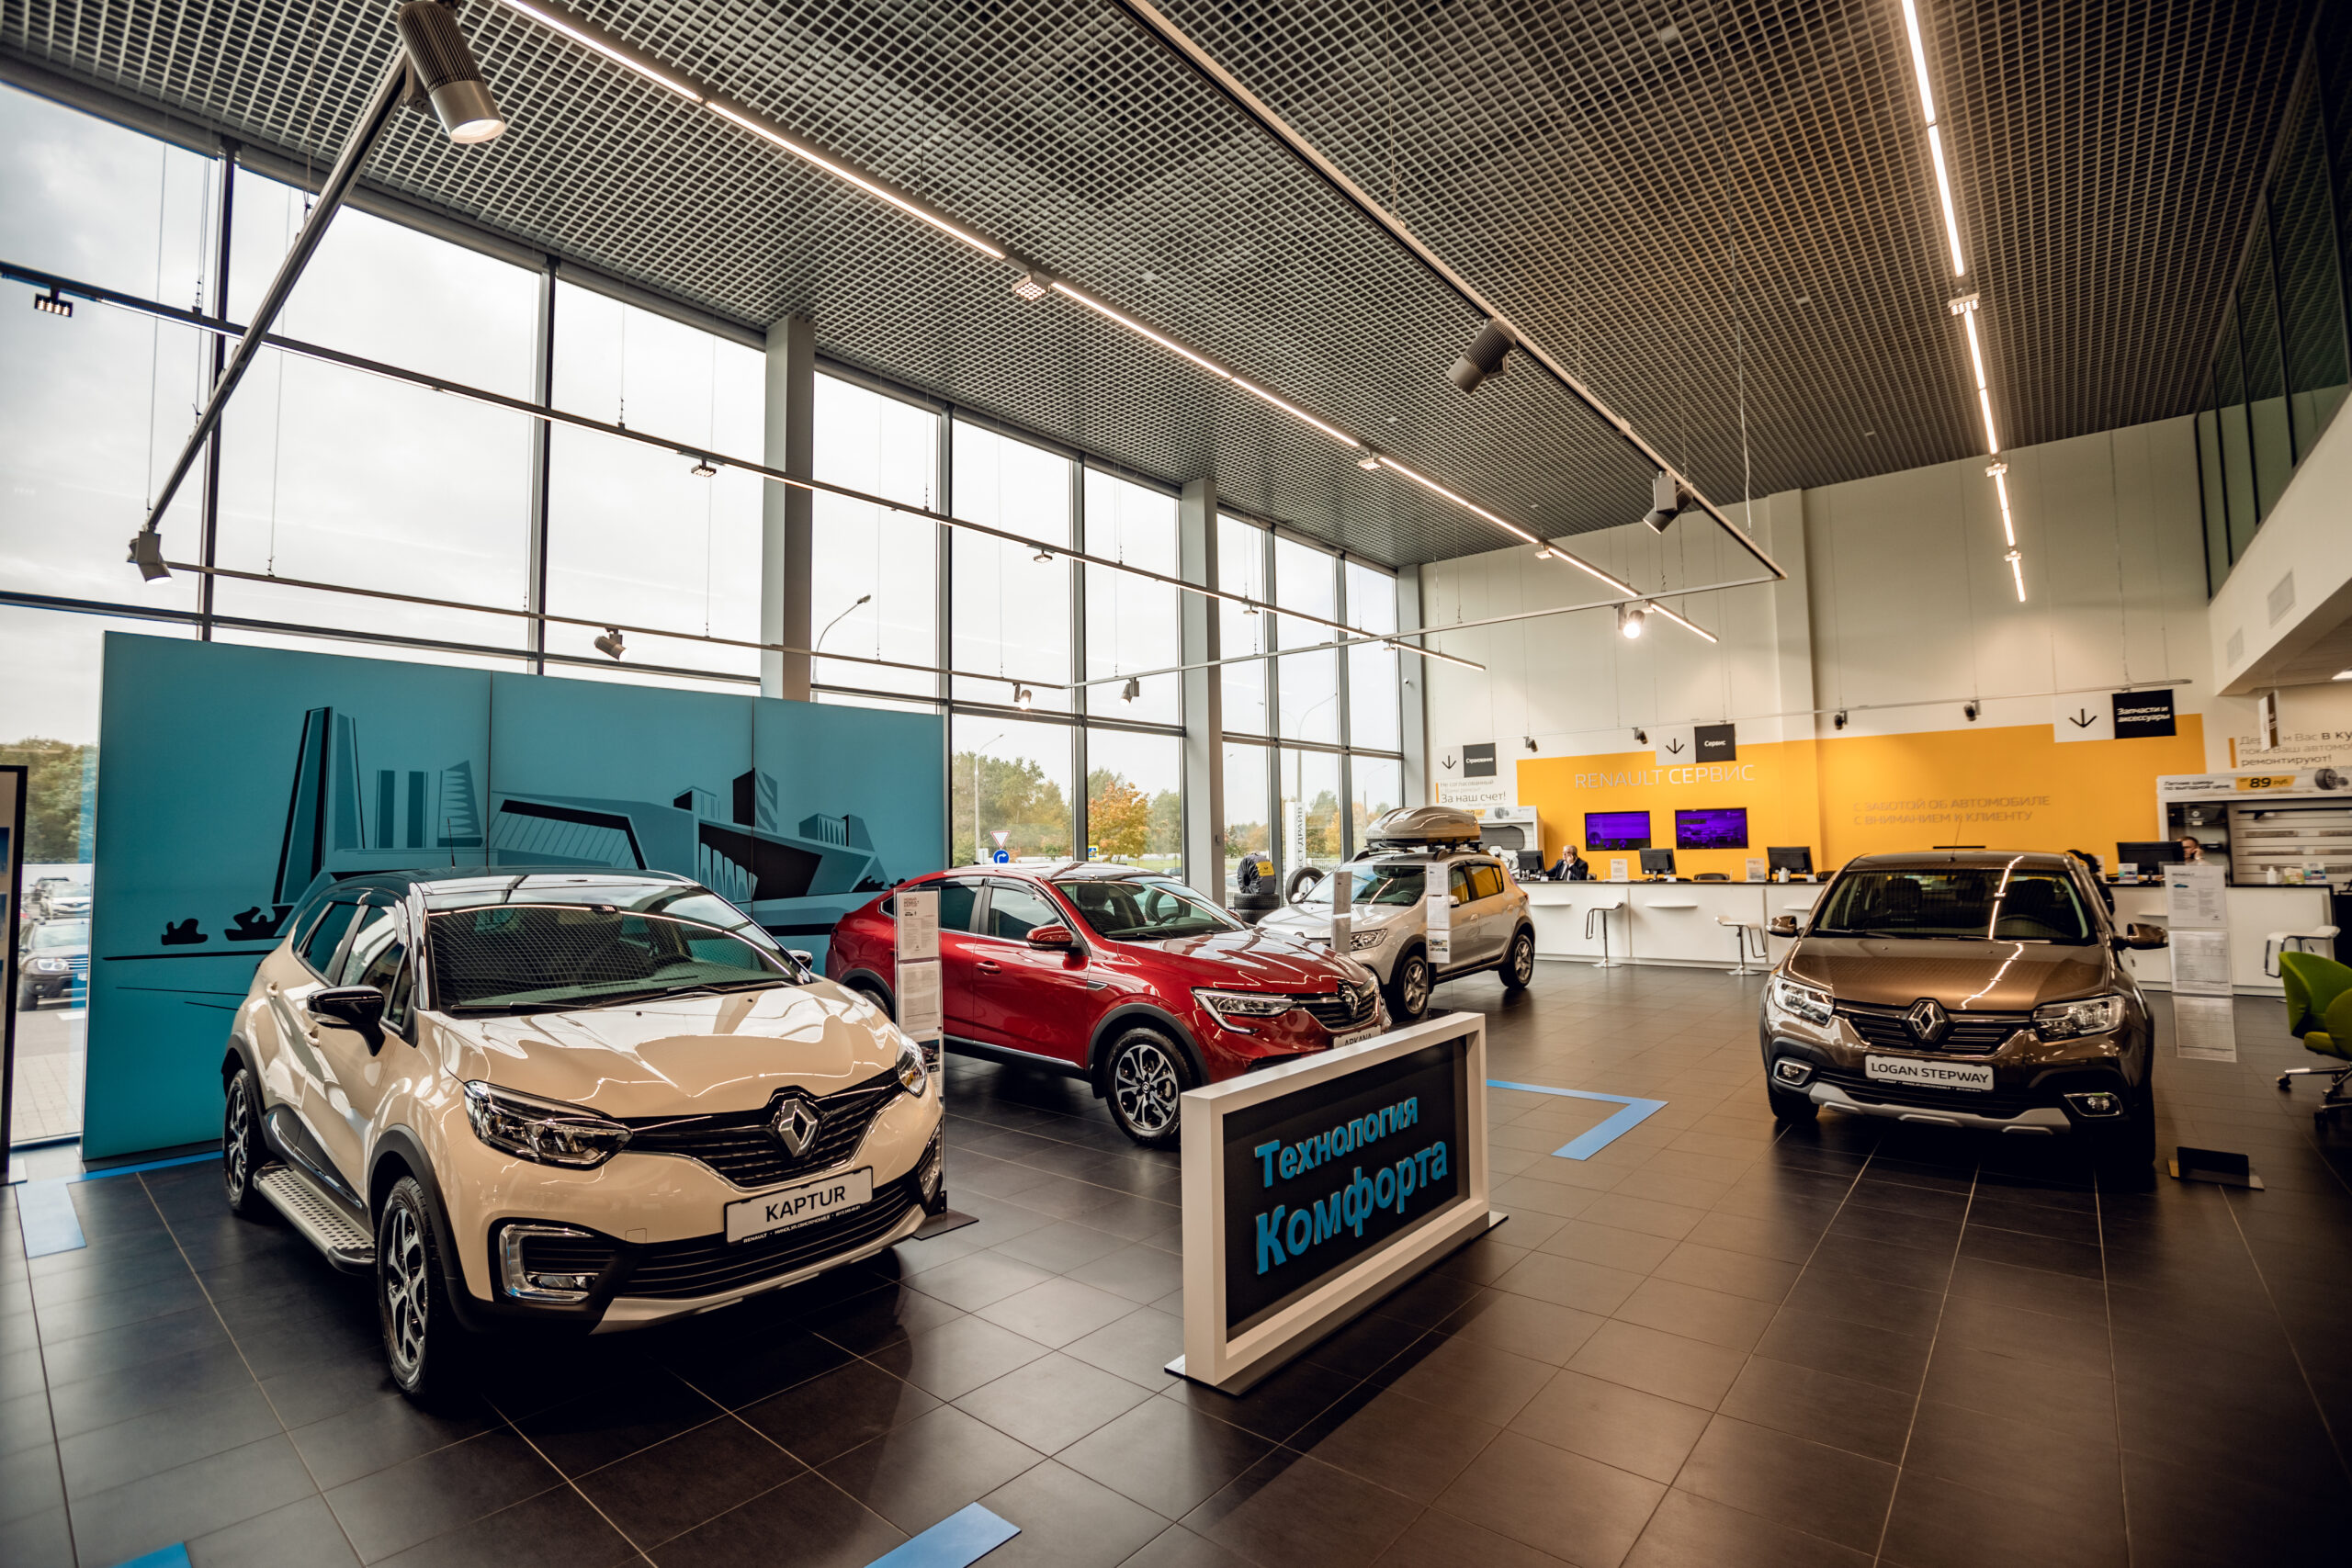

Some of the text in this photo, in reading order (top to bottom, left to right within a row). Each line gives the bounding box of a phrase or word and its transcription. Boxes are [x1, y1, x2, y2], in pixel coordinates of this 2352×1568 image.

[1704, 739, 1726, 748] Сервис
[2303, 743, 2352, 752] автомо
[2241, 754, 2332, 767] ремонтируют!
[1575, 764, 1756, 789] RENAULT СЕРВИС
[2250, 777, 2272, 788] 89
[1441, 794, 1453, 804] За
[1456, 794, 1477, 803] наш
[1480, 791, 1507, 802] счет!
[1864, 798, 1926, 811] ЗАБОТОЙ
[1928, 798, 1948, 809] ОБ
[1951, 795, 2051, 809] АВТОМОБИЛЕ
[1864, 813, 1951, 825] ВНИМАНИЕМ
[1966, 811, 2033, 822] КЛИЕНТУ
[1871, 1062, 1989, 1083] LOGAN STEPWAY
[1254, 1097, 1419, 1189] Технология
[765, 1185, 846, 1223] KAPTUR
[1255, 1141, 1448, 1276] Комфорта
[743, 1233, 767, 1244] RENAULT
